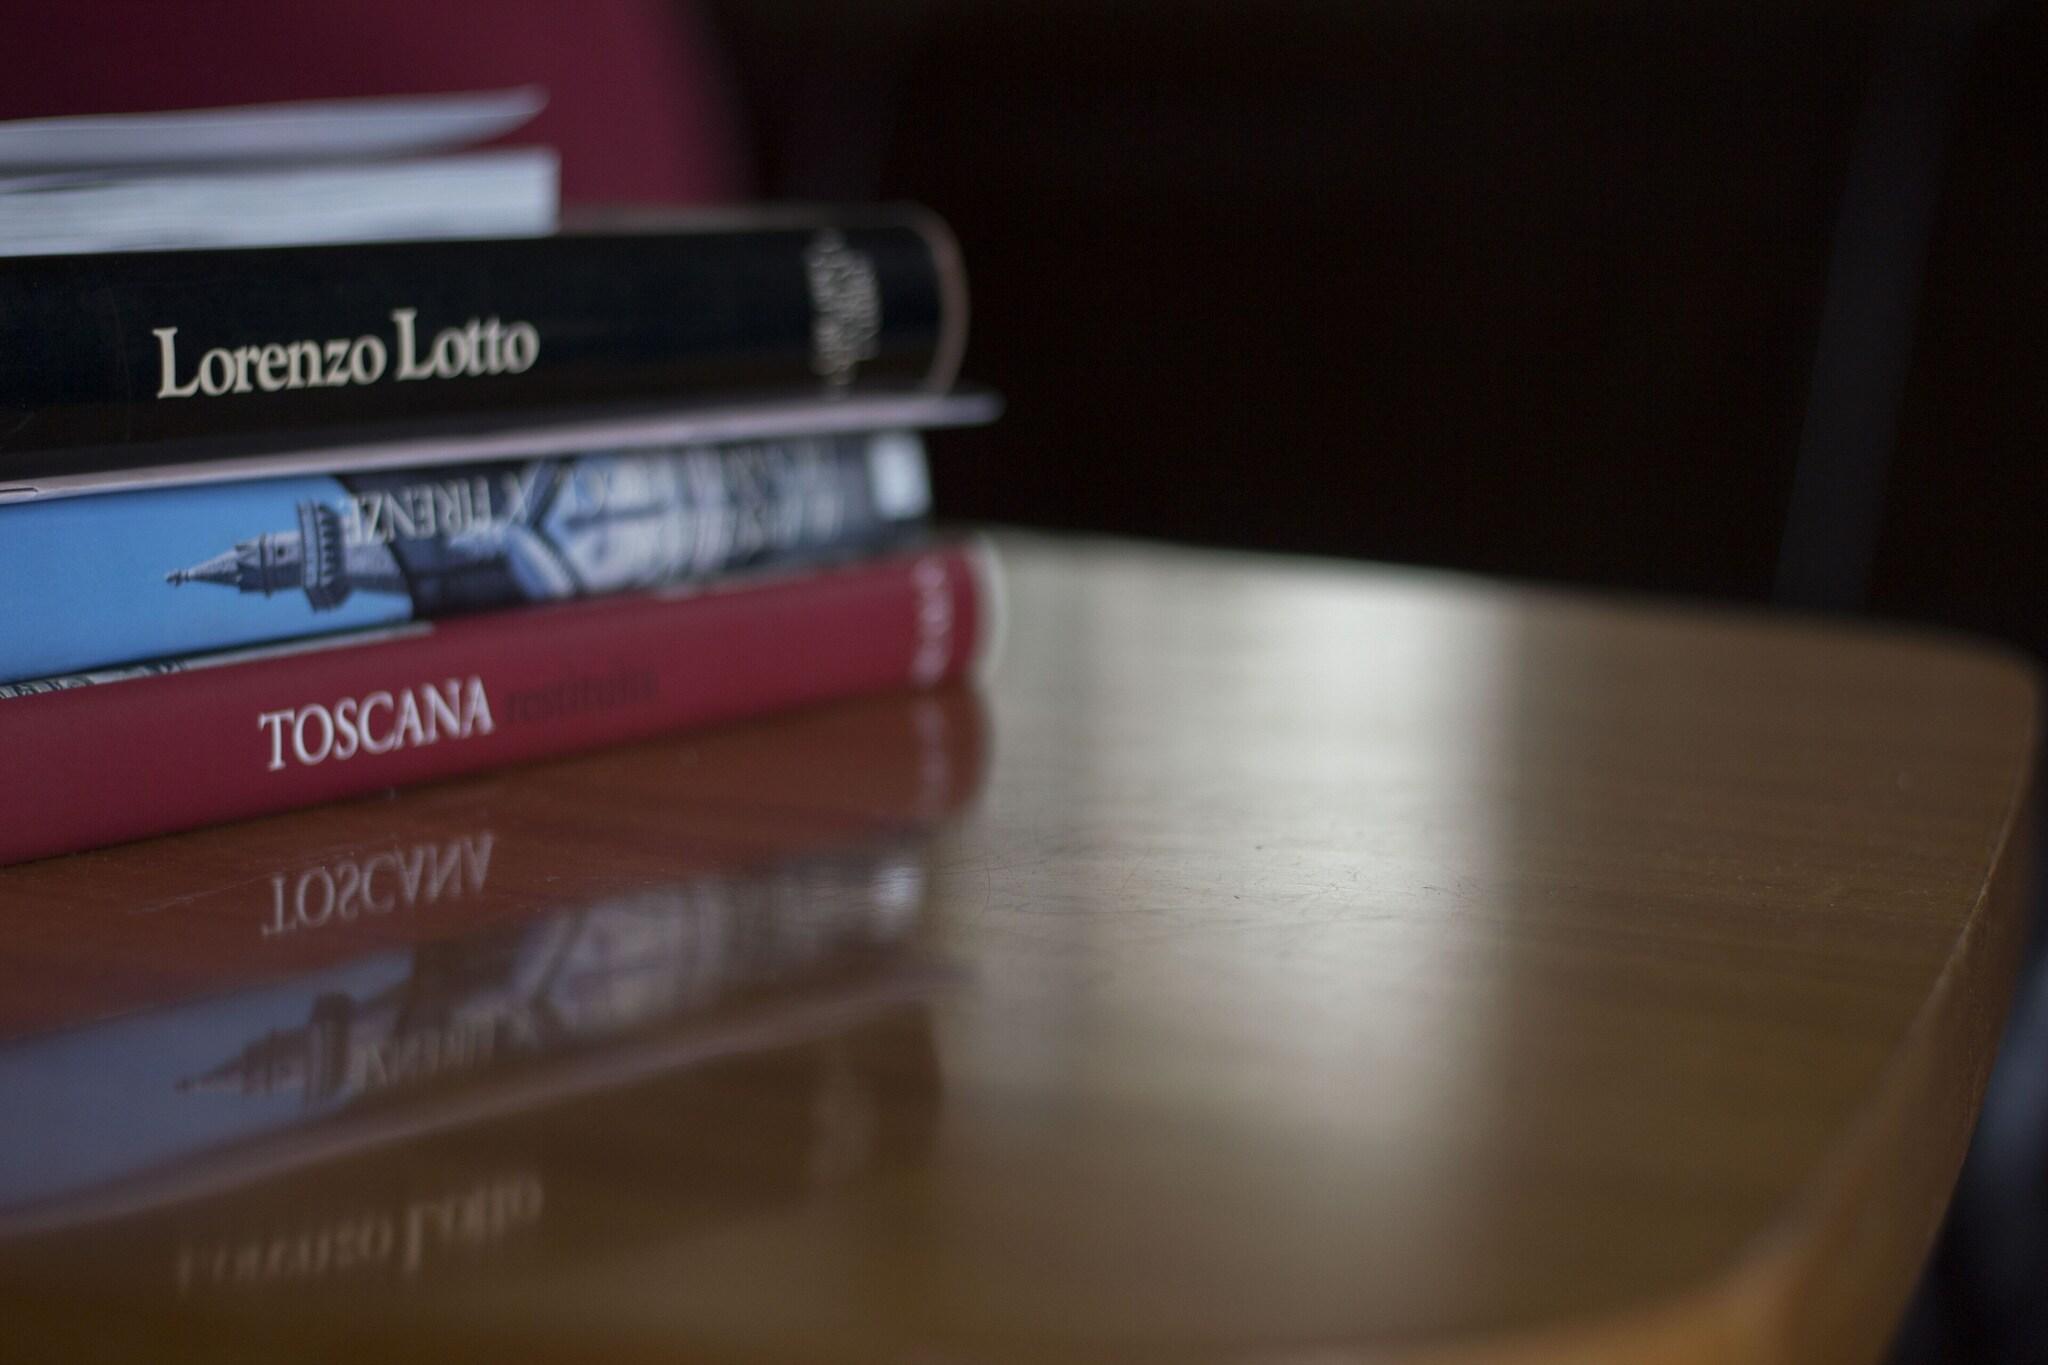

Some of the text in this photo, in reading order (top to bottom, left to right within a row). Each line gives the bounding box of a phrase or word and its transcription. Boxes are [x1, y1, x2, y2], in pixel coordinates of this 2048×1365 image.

[152, 306, 542, 400] Lorenzo Lotto
[344, 474, 494, 546] FIRENZE
[258, 674, 497, 772] TOSCANA
